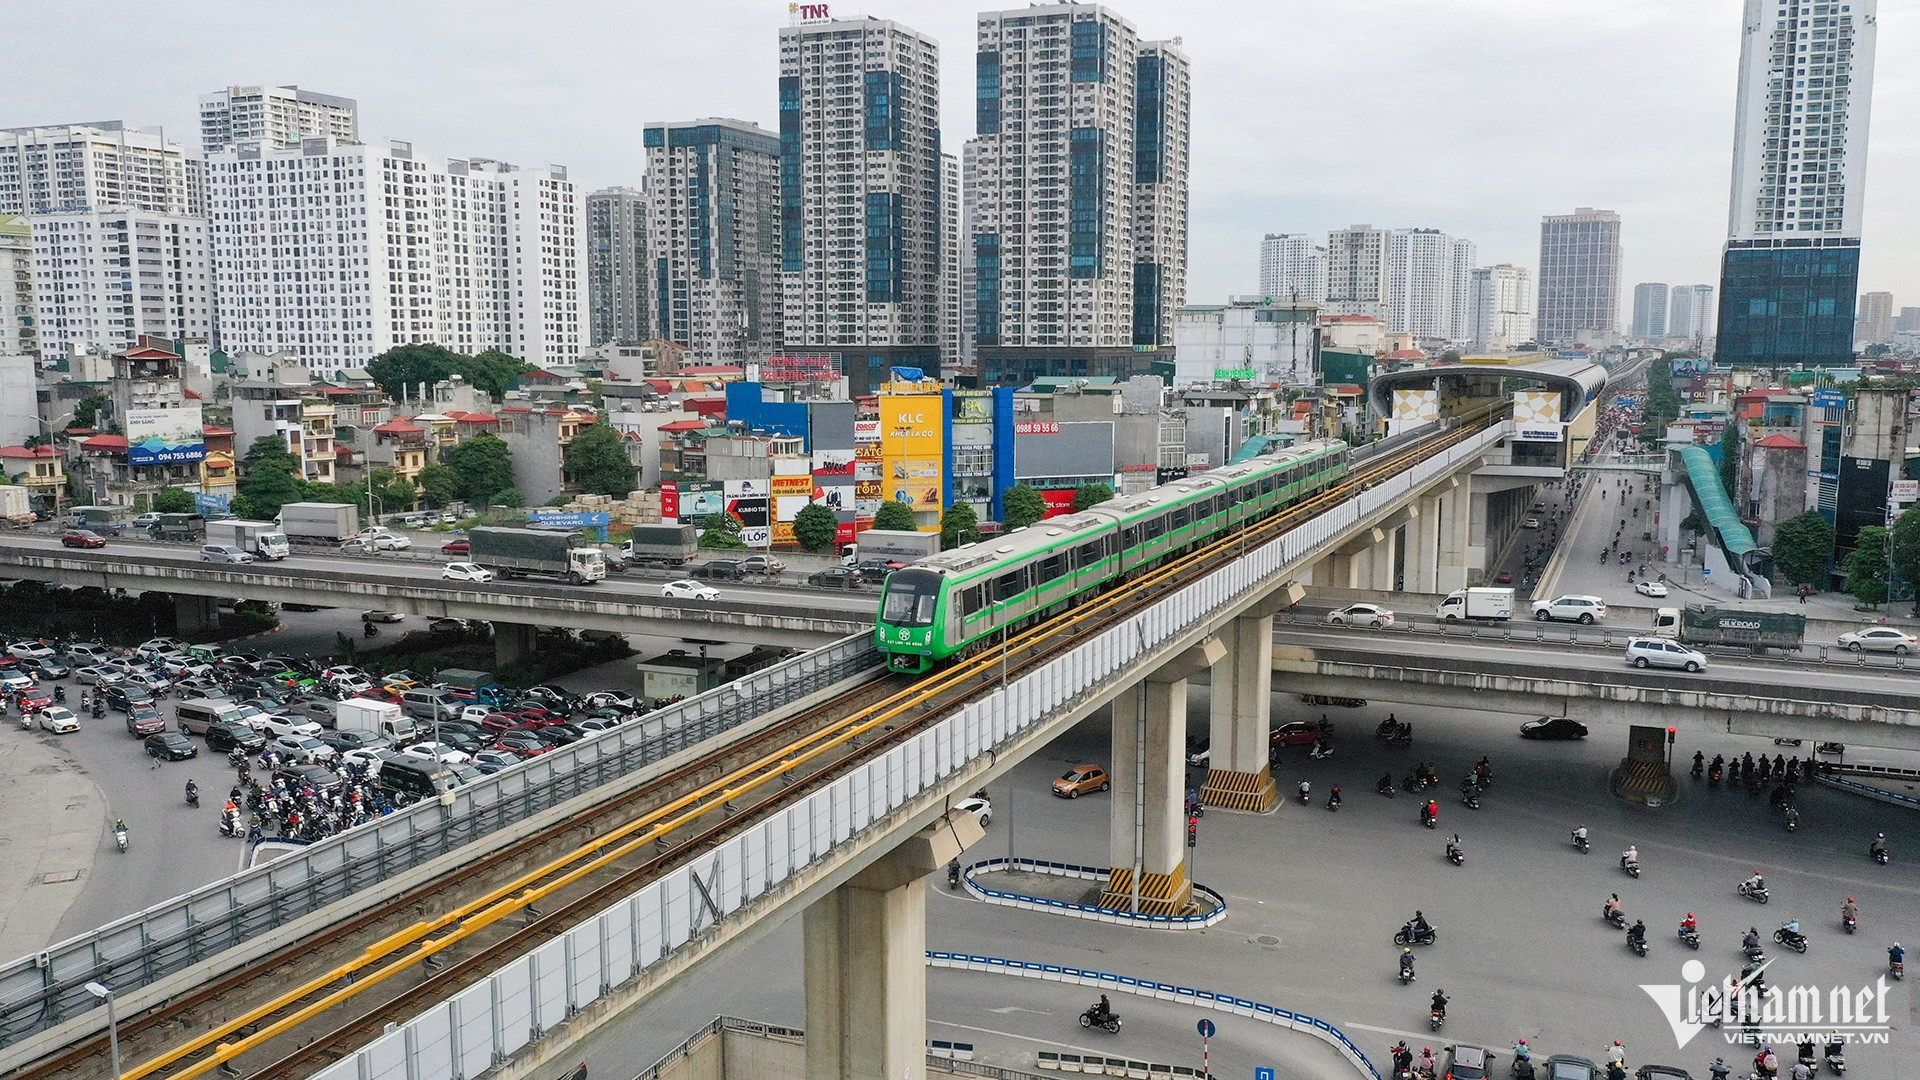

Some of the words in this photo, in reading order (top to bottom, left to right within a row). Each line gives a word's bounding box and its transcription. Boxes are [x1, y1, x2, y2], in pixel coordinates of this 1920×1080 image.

[800, 4, 829, 19] TNR
[898, 413, 925, 423] KLC
[1016, 424, 1032, 432] 0988
[1033, 423, 1041, 432] 59
[1042, 423, 1050, 432] 55
[1051, 423, 1059, 432] 66
[772, 478, 810, 487] VIETNEST
[856, 485, 883, 494] TOPY
[1719, 620, 1761, 629] SILKROAD
